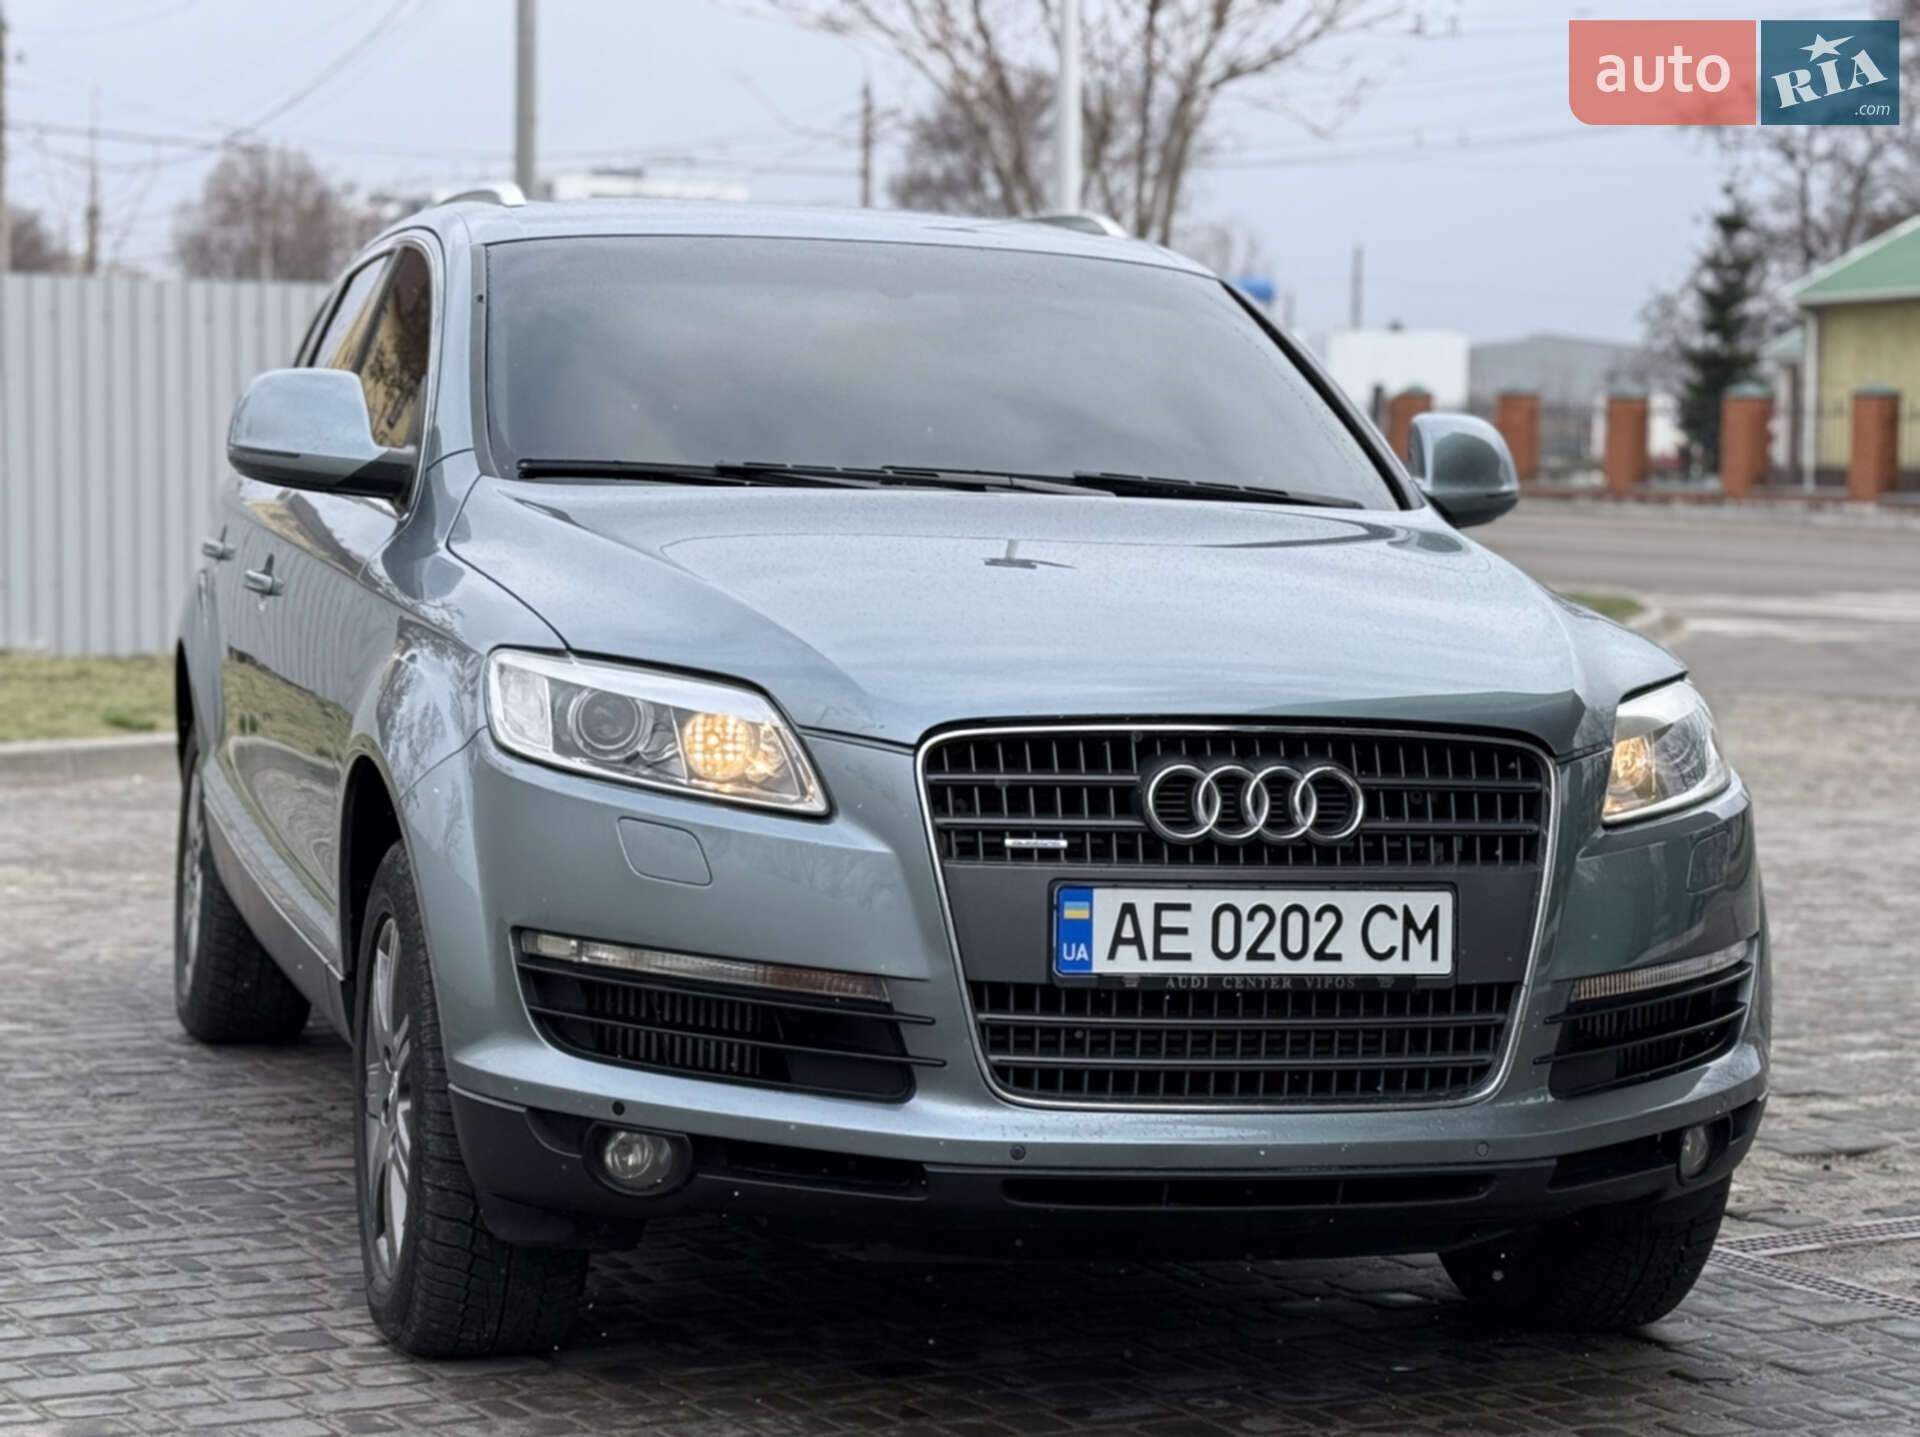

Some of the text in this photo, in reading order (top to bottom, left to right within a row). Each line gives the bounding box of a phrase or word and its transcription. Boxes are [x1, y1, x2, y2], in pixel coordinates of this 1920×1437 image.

[1106, 902, 1439, 961] AE 0202 CM
[1063, 943, 1089, 961] UA
[1165, 976, 1356, 989] AUDI CENTER VIPOS
